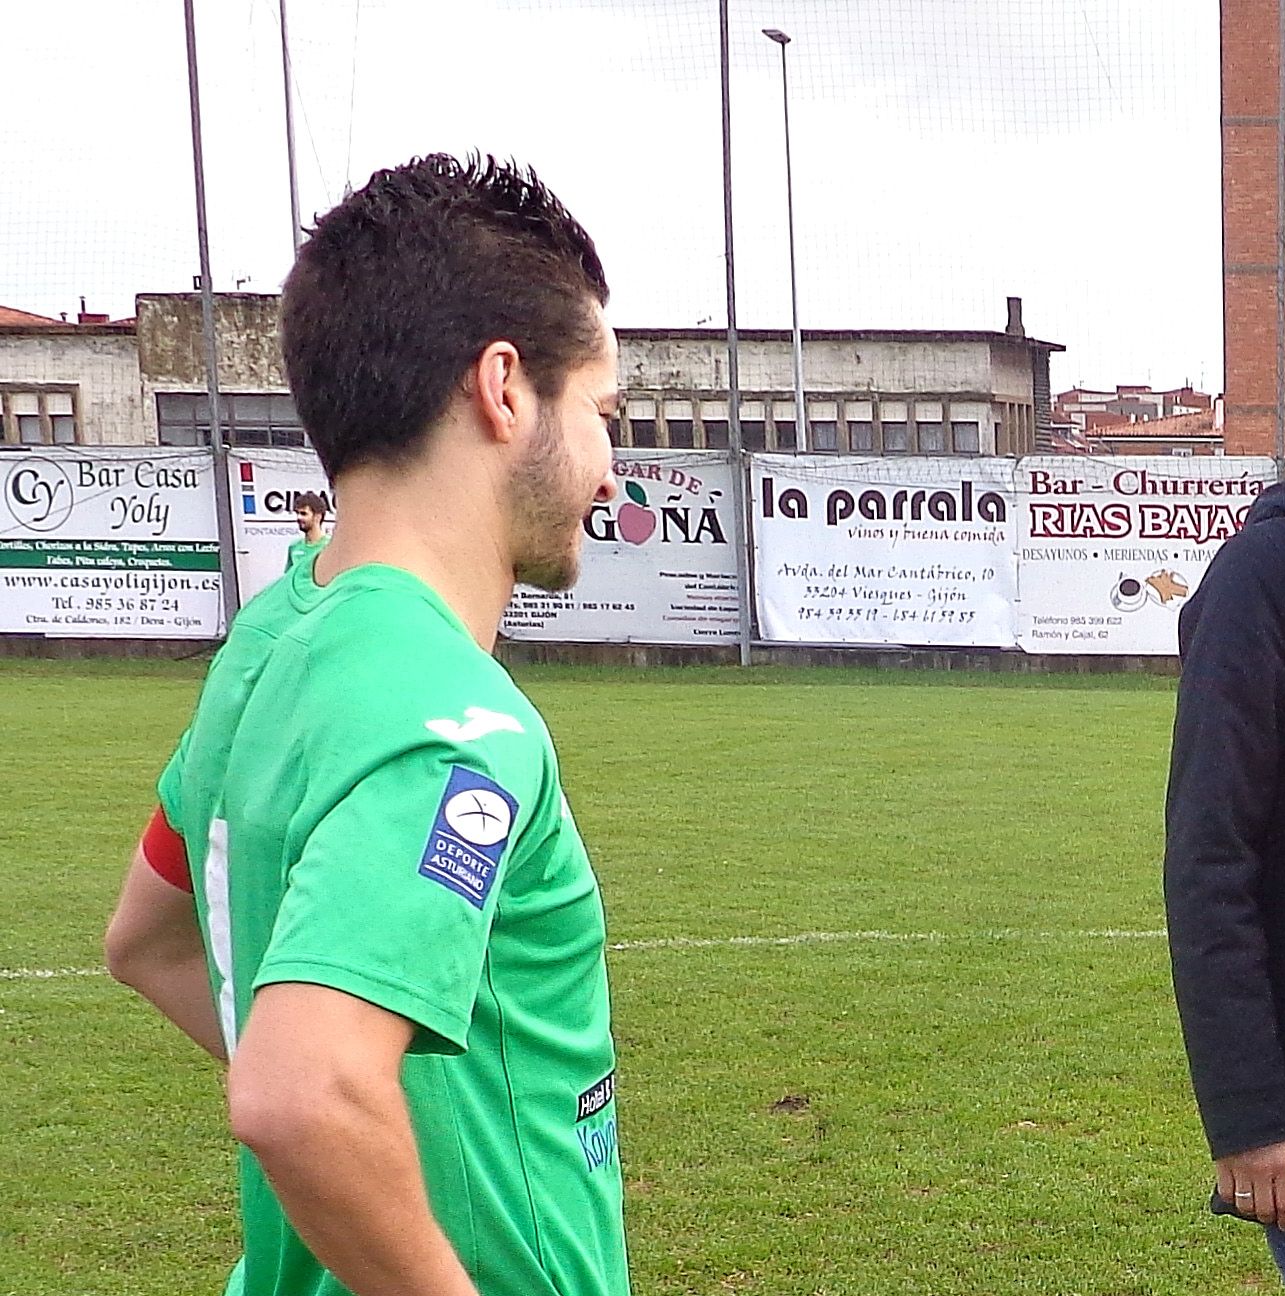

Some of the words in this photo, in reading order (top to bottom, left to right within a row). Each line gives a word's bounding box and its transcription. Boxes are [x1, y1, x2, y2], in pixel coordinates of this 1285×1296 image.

[77, 460, 125, 488] Bar
[134, 461, 200, 488] Casa
[669, 469, 703, 496] DE
[1029, 471, 1083, 495] Bar
[1113, 469, 1264, 496] Churrería
[110, 492, 169, 536] Yoly
[762, 477, 808, 519] la
[827, 480, 1006, 526] parrala
[1030, 503, 1132, 538] RIAS
[848, 523, 884, 539] vinos
[889, 529, 899, 549] y
[954, 526, 1005, 547] comida
[1022, 549, 1088, 560] DESAYUNOS
[1104, 549, 1168, 562] MERIENDAS
[4, 572, 219, 596] www.casayoligijon.es
[828, 563, 848, 582] del
[854, 565, 883, 578] Mar
[86, 598, 112, 610] 985
[117, 598, 135, 610] 36
[140, 599, 156, 611] 87
[161, 599, 178, 611] 24
[928, 587, 966, 609] Gijón
[1033, 616, 1069, 625] Teléfono
[1032, 629, 1062, 639] Ramón
[1064, 632, 1069, 640] y
[436, 839, 490, 878] DEPORTE
[431, 854, 484, 891] ASTURIANO
